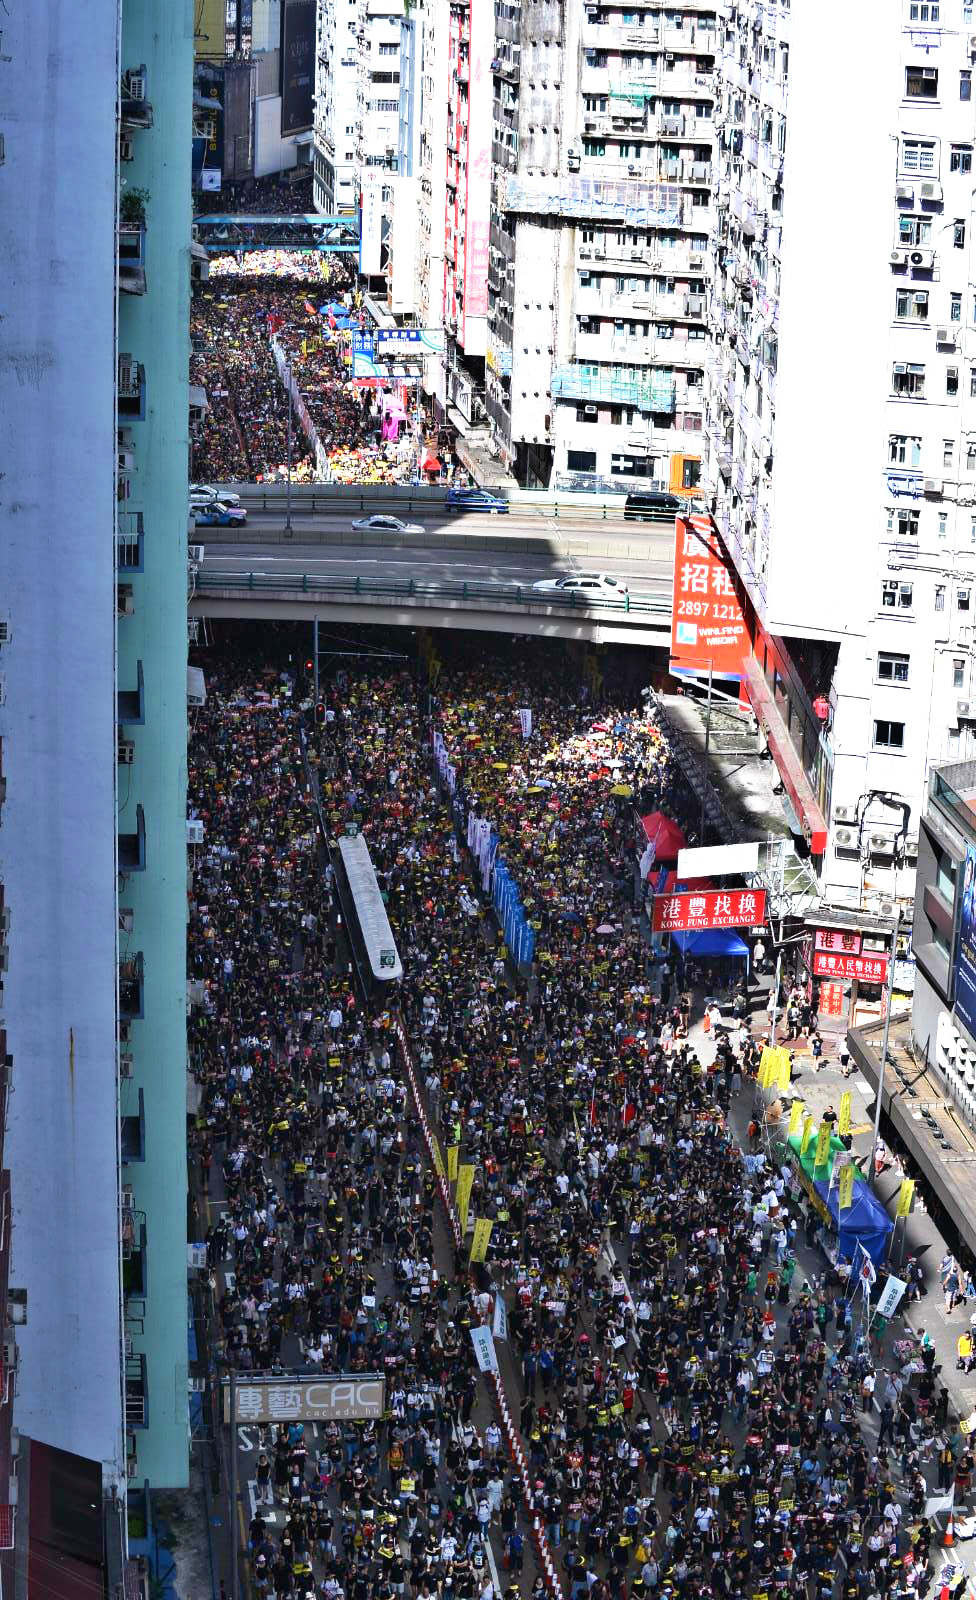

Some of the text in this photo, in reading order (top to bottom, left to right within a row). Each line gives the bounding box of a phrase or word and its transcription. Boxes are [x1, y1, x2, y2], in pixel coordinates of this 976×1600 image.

[681, 562, 736, 596] 招租
[677, 600, 743, 620] 2897 1212
[699, 625, 743, 636] WINLAND
[706, 636, 738, 646] MEDIA
[662, 893, 757, 919] 港豐找換
[661, 914, 756, 929] KONG FUNG EXCHANGE
[820, 932, 856, 951] 港豐
[818, 955, 882, 976] 港豐人民幣找換
[238, 1383, 380, 1420] 專藝 CAC
